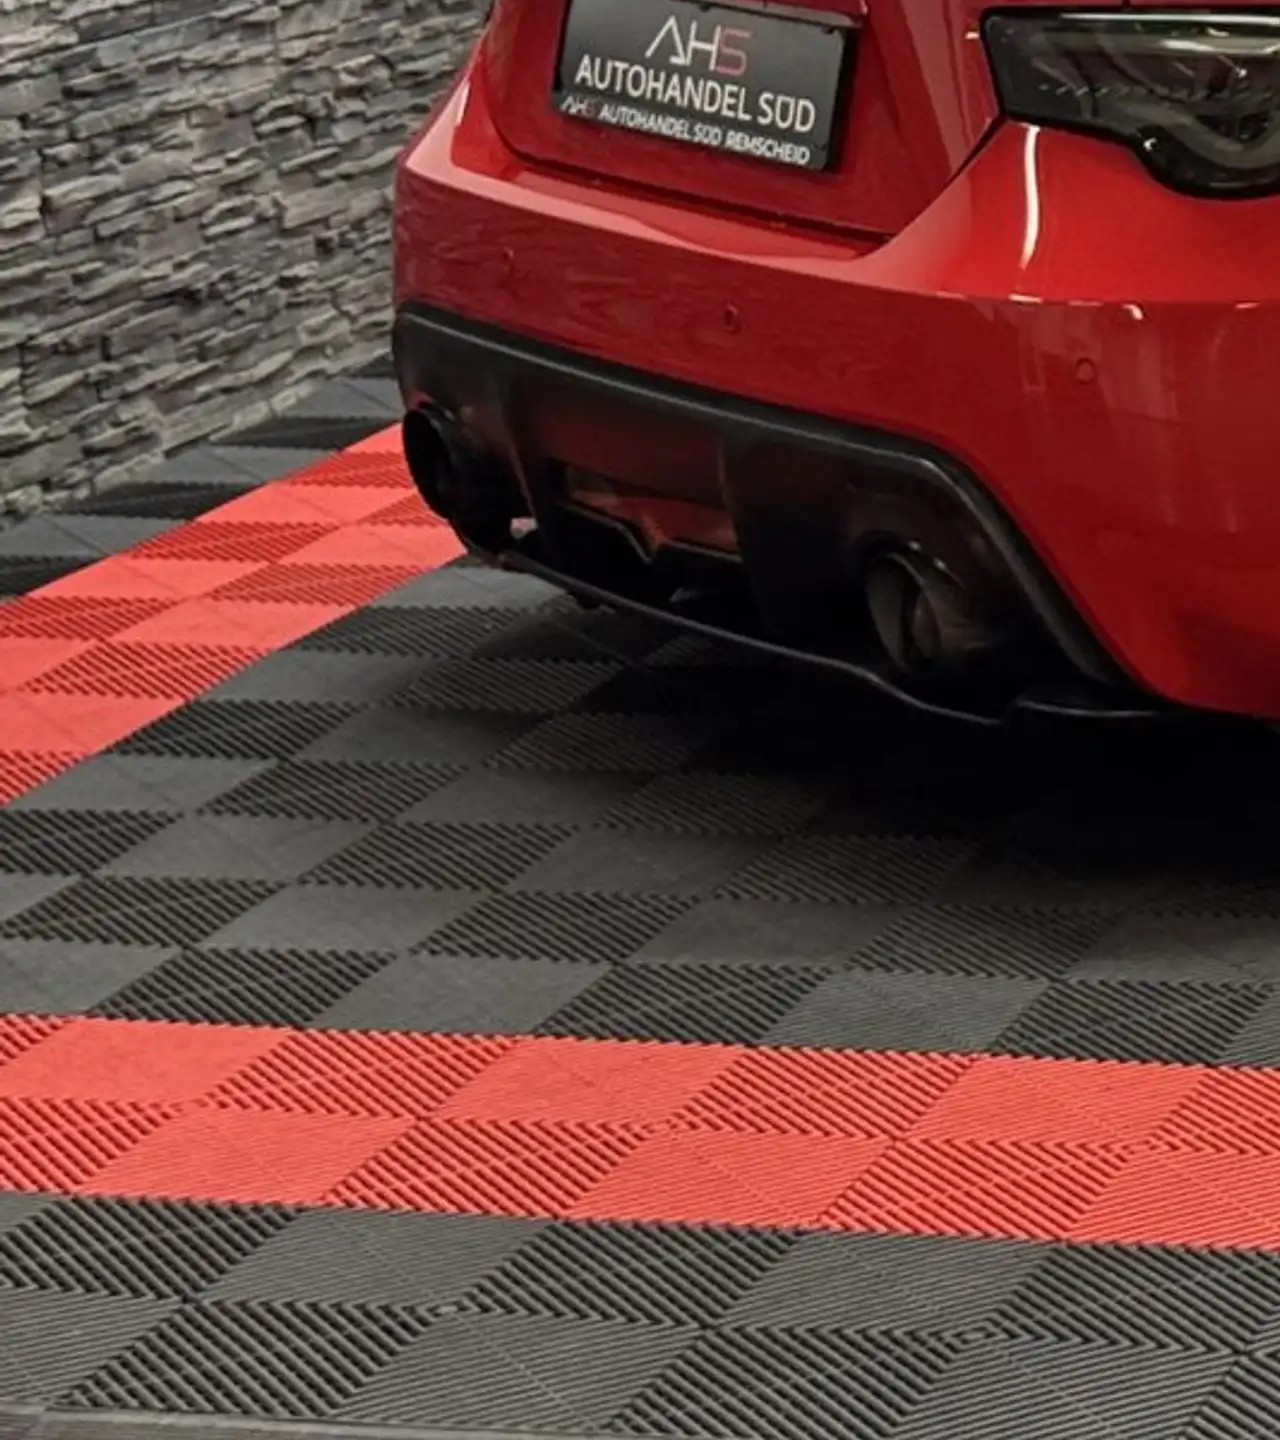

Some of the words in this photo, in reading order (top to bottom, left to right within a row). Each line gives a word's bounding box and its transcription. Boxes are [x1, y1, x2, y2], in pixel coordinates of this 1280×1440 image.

[645, 14, 751, 77] AHS
[574, 53, 753, 121] AUTOHANDEL
[756, 91, 816, 134] SÜD
[598, 102, 692, 140] AUTOHANDEL
[723, 128, 811, 166] REMSCHEID
